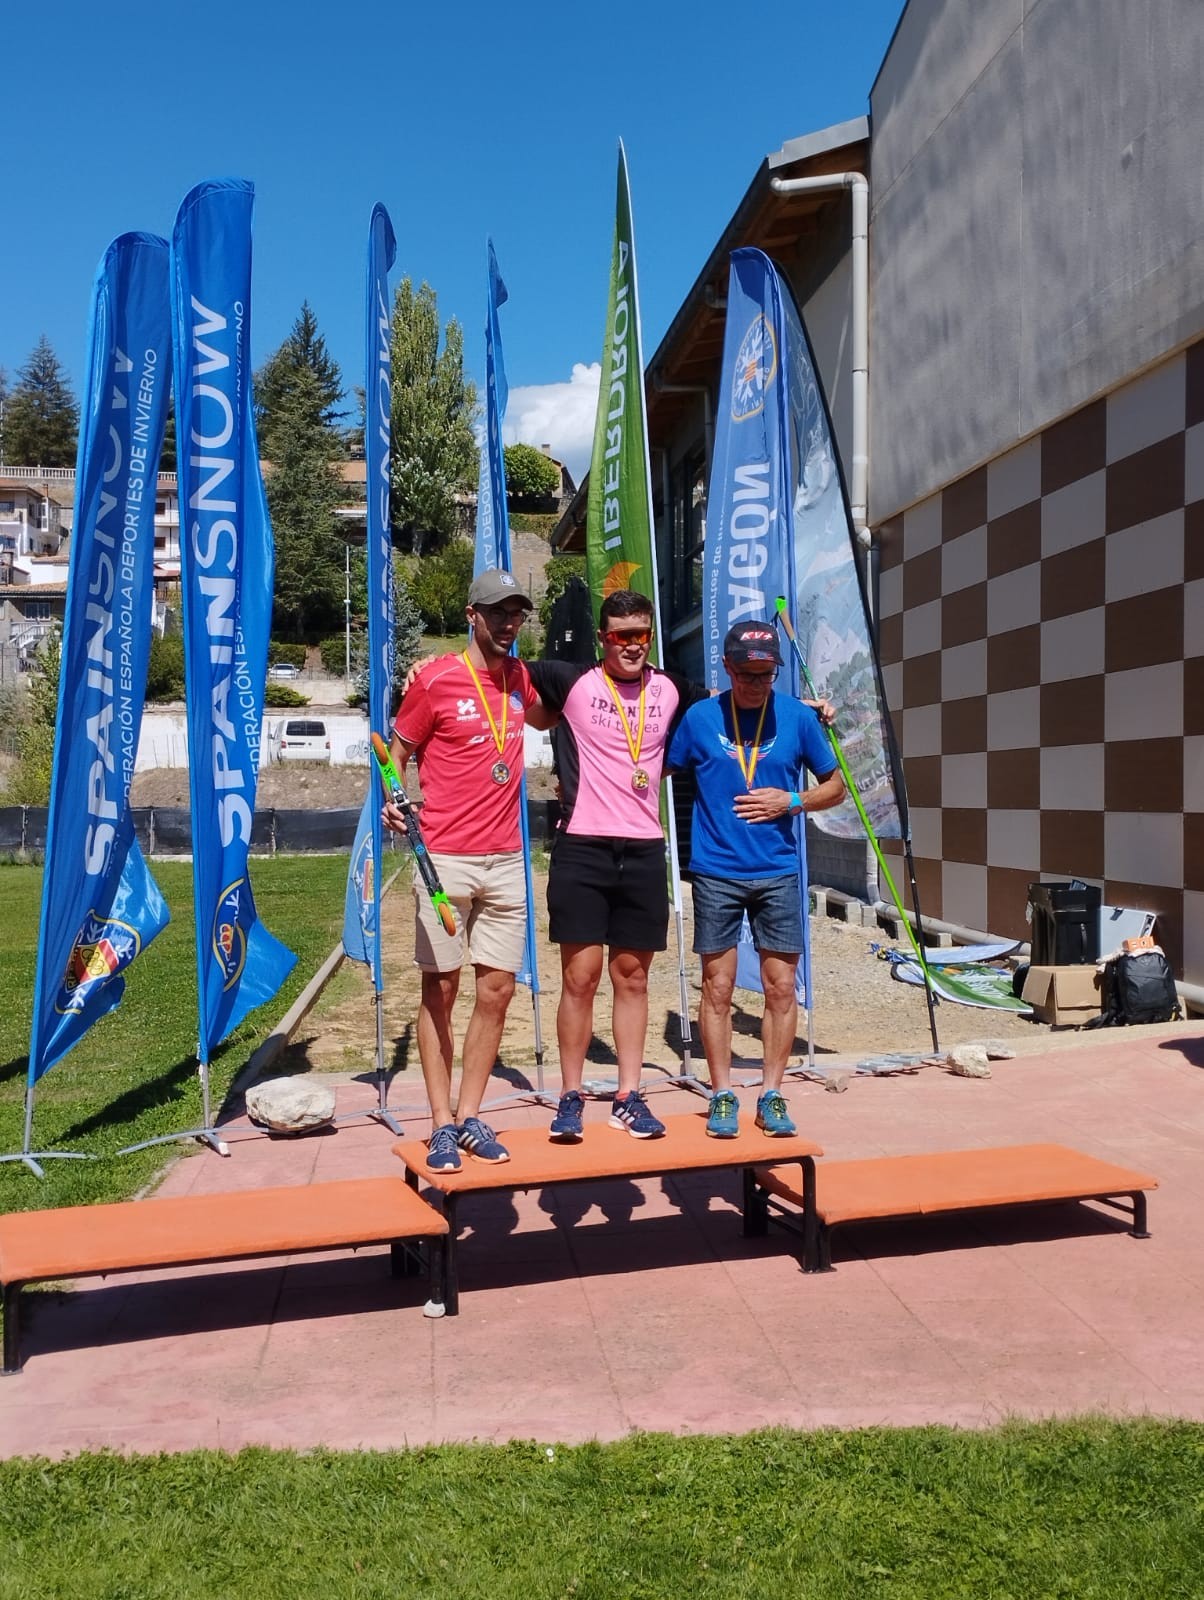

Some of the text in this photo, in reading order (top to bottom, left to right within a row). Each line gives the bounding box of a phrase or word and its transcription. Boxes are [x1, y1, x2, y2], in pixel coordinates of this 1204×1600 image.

[133, 348, 157, 444] INVIERNO
[130, 445, 147, 473] DE
[121, 477, 144, 581] DEPORTES
[190, 294, 252, 847] SPAINSNOW
[120, 586, 133, 694] ESPAÑOLA
[590, 696, 662, 718] IRRNZI
[591, 714, 611, 728] ski
